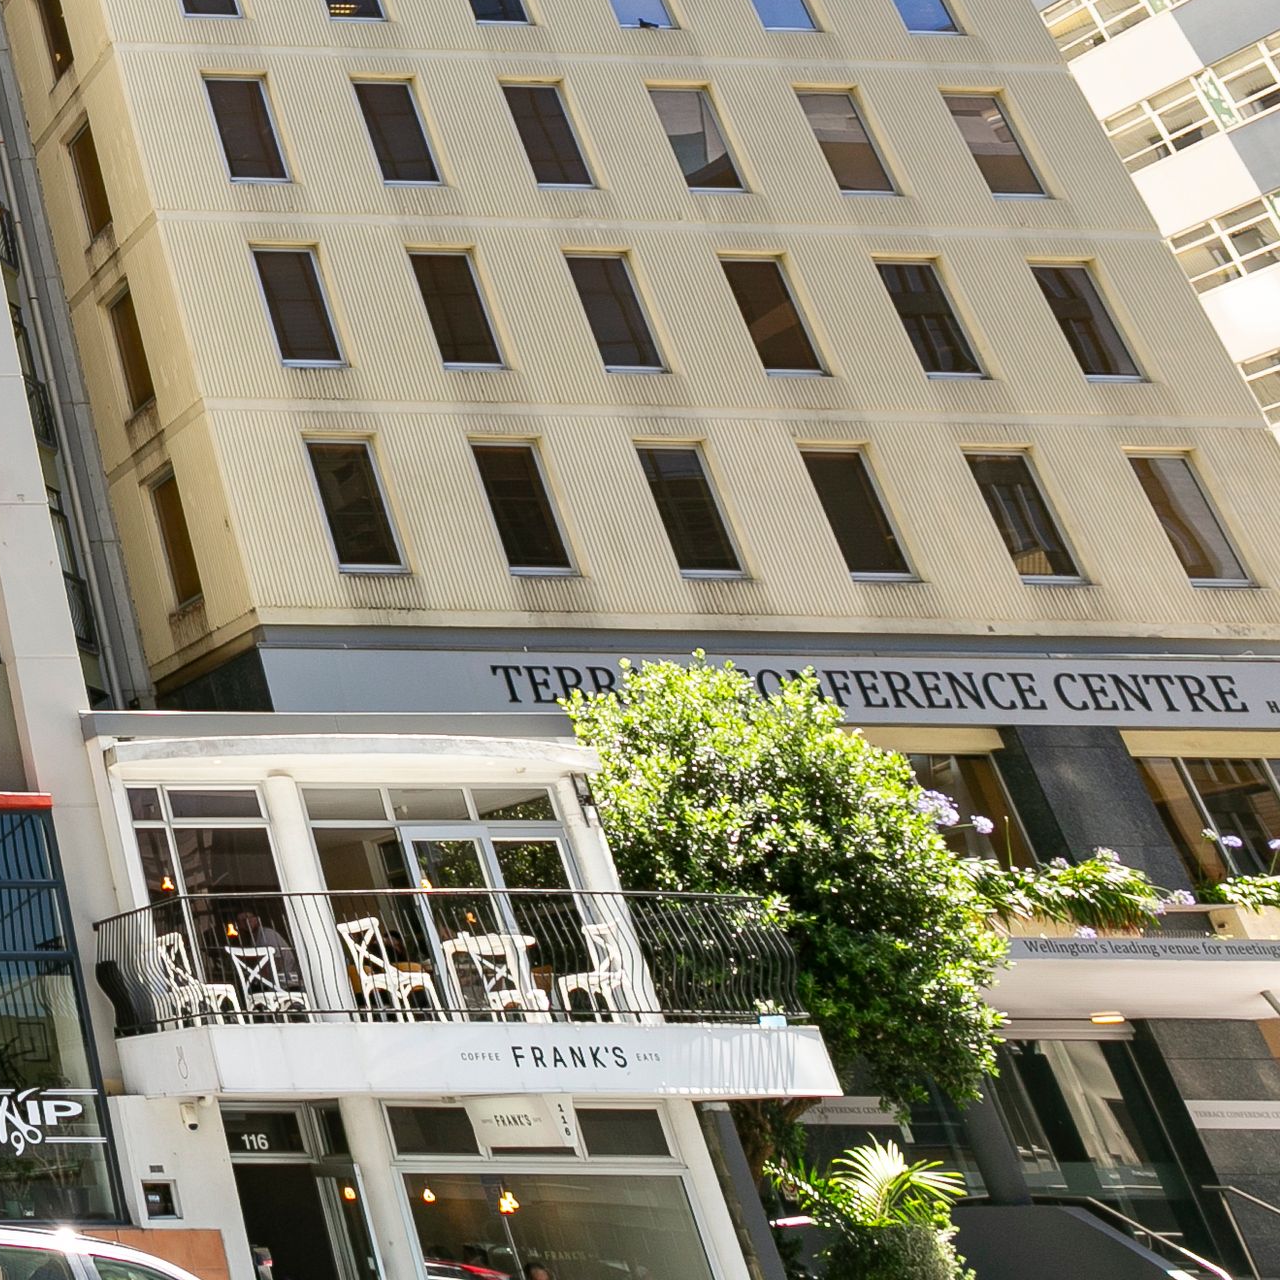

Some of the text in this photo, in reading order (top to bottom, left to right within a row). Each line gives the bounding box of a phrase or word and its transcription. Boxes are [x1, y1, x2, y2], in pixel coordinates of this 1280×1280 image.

[735, 668, 1048, 710] OFERENCE
[1053, 672, 1248, 713] CENTRE
[1023, 939, 1107, 956] Wellington's
[1110, 941, 1159, 957] leading
[1160, 943, 1200, 955] venue
[1202, 941, 1221, 954] for
[461, 1046, 661, 1068] COFFEE FRANK'S EATS
[493, 1114, 532, 1127] FRANK'S
[557, 1104, 571, 1136] 116
[241, 1134, 269, 1150] 116
